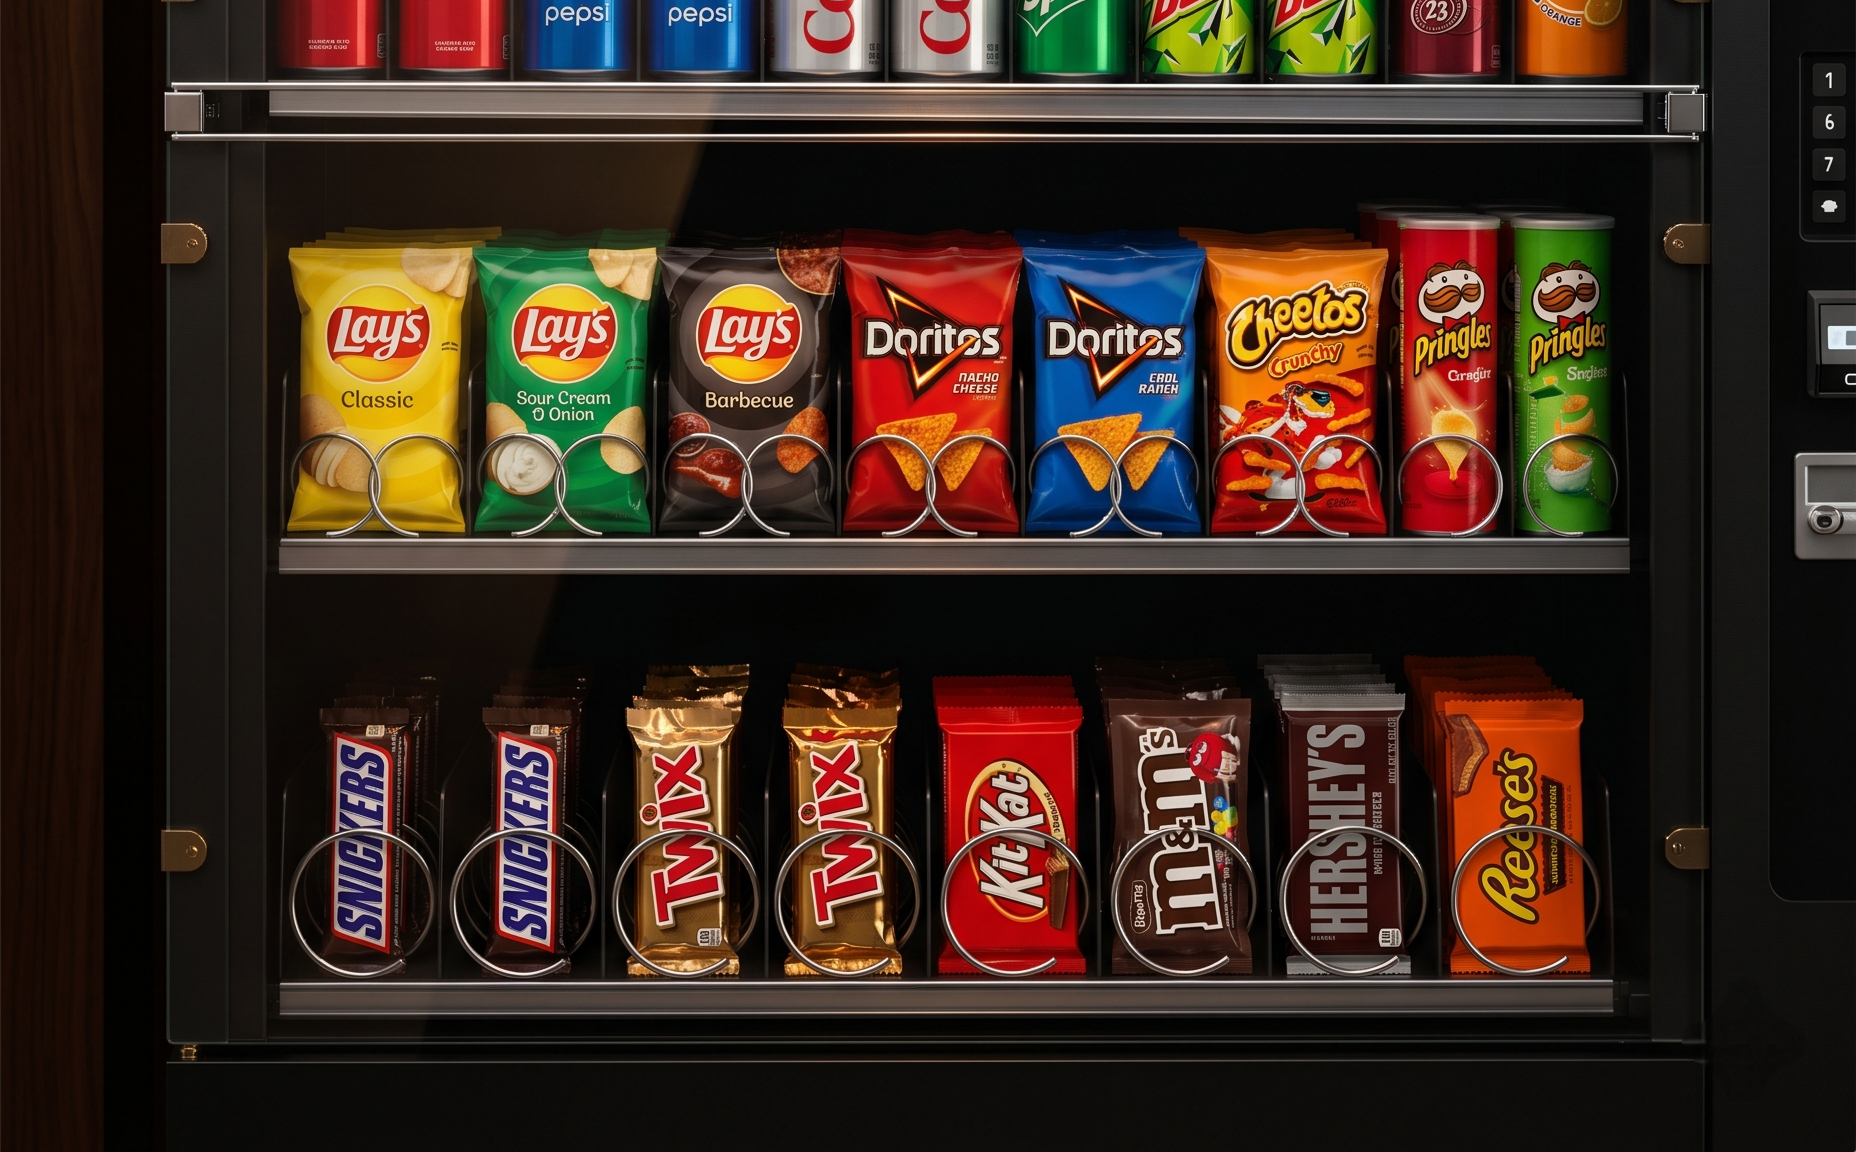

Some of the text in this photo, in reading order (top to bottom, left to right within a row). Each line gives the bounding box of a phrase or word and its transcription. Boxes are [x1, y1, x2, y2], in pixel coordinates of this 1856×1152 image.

[545, 3, 610, 26] pepsi
[669, 3, 732, 27] pepsi
[1425, 0, 1448, 21] 23
[1825, 72, 1833, 89] 1
[1825, 113, 1835, 130] 6
[1824, 156, 1834, 173] 7
[333, 307, 424, 361] Lay's
[520, 307, 611, 361] Lay's
[704, 308, 795, 361] Lay's
[866, 321, 1000, 356] Doritos
[1049, 321, 1184, 356] Doritos
[1228, 283, 1367, 365] Cheetos
[1269, 342, 1343, 377] Crunchy
[1414, 317, 1492, 376] Pringles
[1530, 320, 1607, 376] Pringles
[953, 384, 998, 394] CHEESE
[958, 373, 1000, 383] NACHO
[341, 390, 414, 409] Classic
[516, 390, 611, 405] Sour Cream
[549, 407, 594, 422] Onion
[705, 391, 794, 409] Barbecue
[337, 744, 385, 941] SNICKERS
[502, 743, 550, 941] SNICKERS
[1307, 724, 1368, 934] HERSHEY'S
[1480, 749, 1539, 923] Reese's
